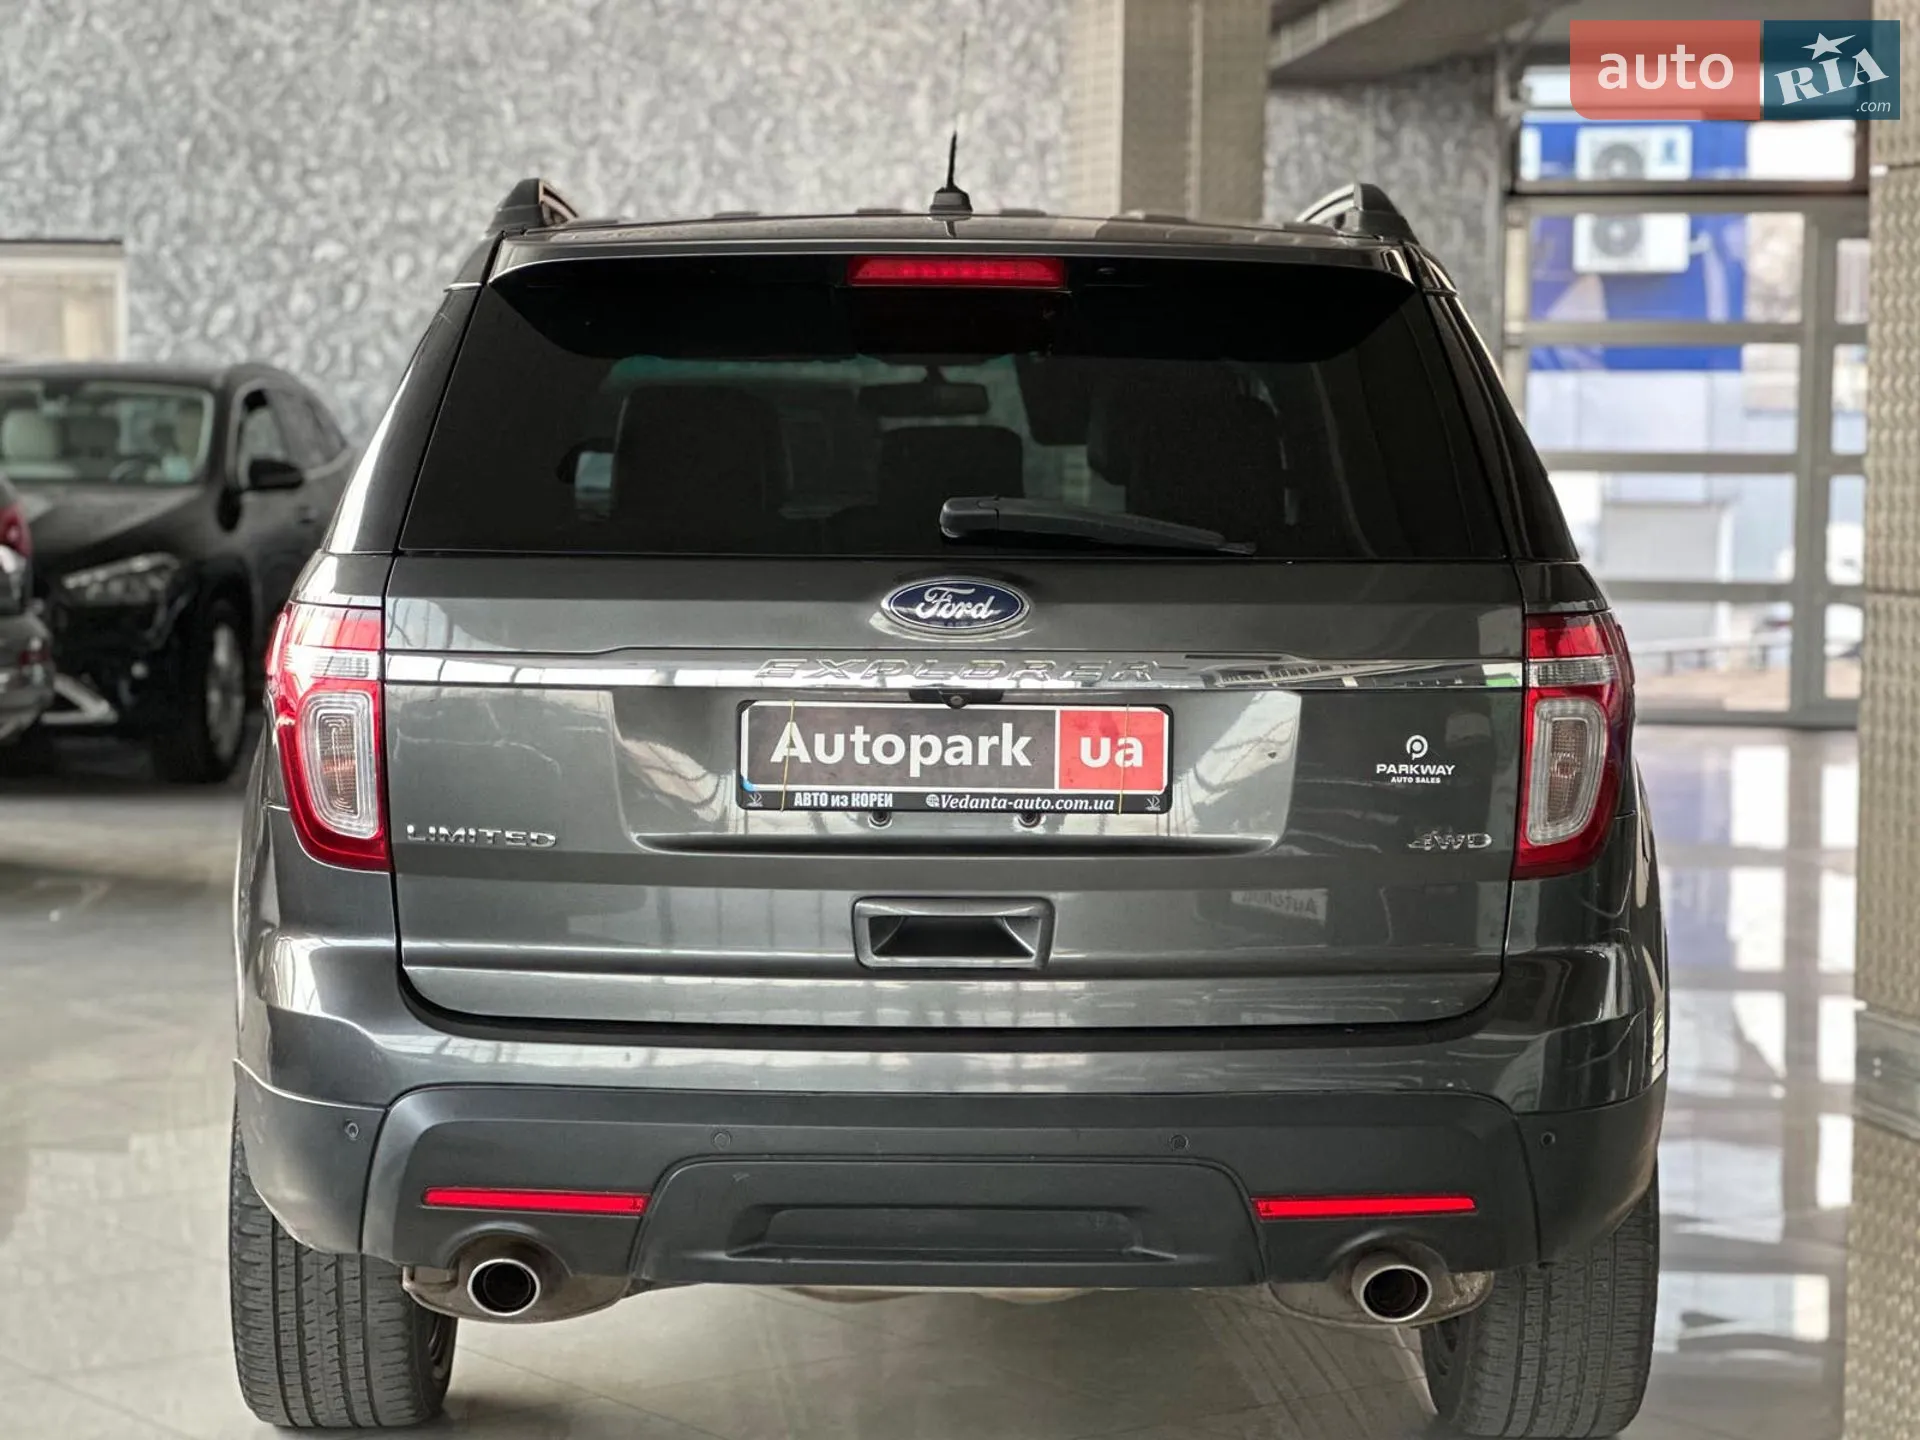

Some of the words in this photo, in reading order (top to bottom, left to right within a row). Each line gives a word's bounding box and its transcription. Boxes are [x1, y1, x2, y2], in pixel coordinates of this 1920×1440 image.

[915, 587, 998, 620] Ford
[754, 658, 1160, 682] EXPLORER
[770, 722, 1033, 778] Autopark
[1079, 736, 1144, 769] ua
[1376, 764, 1455, 775] PARKWAY
[794, 792, 829, 808] АВТО
[406, 824, 556, 848] LIMITED
[1408, 831, 1492, 850] 4WD
